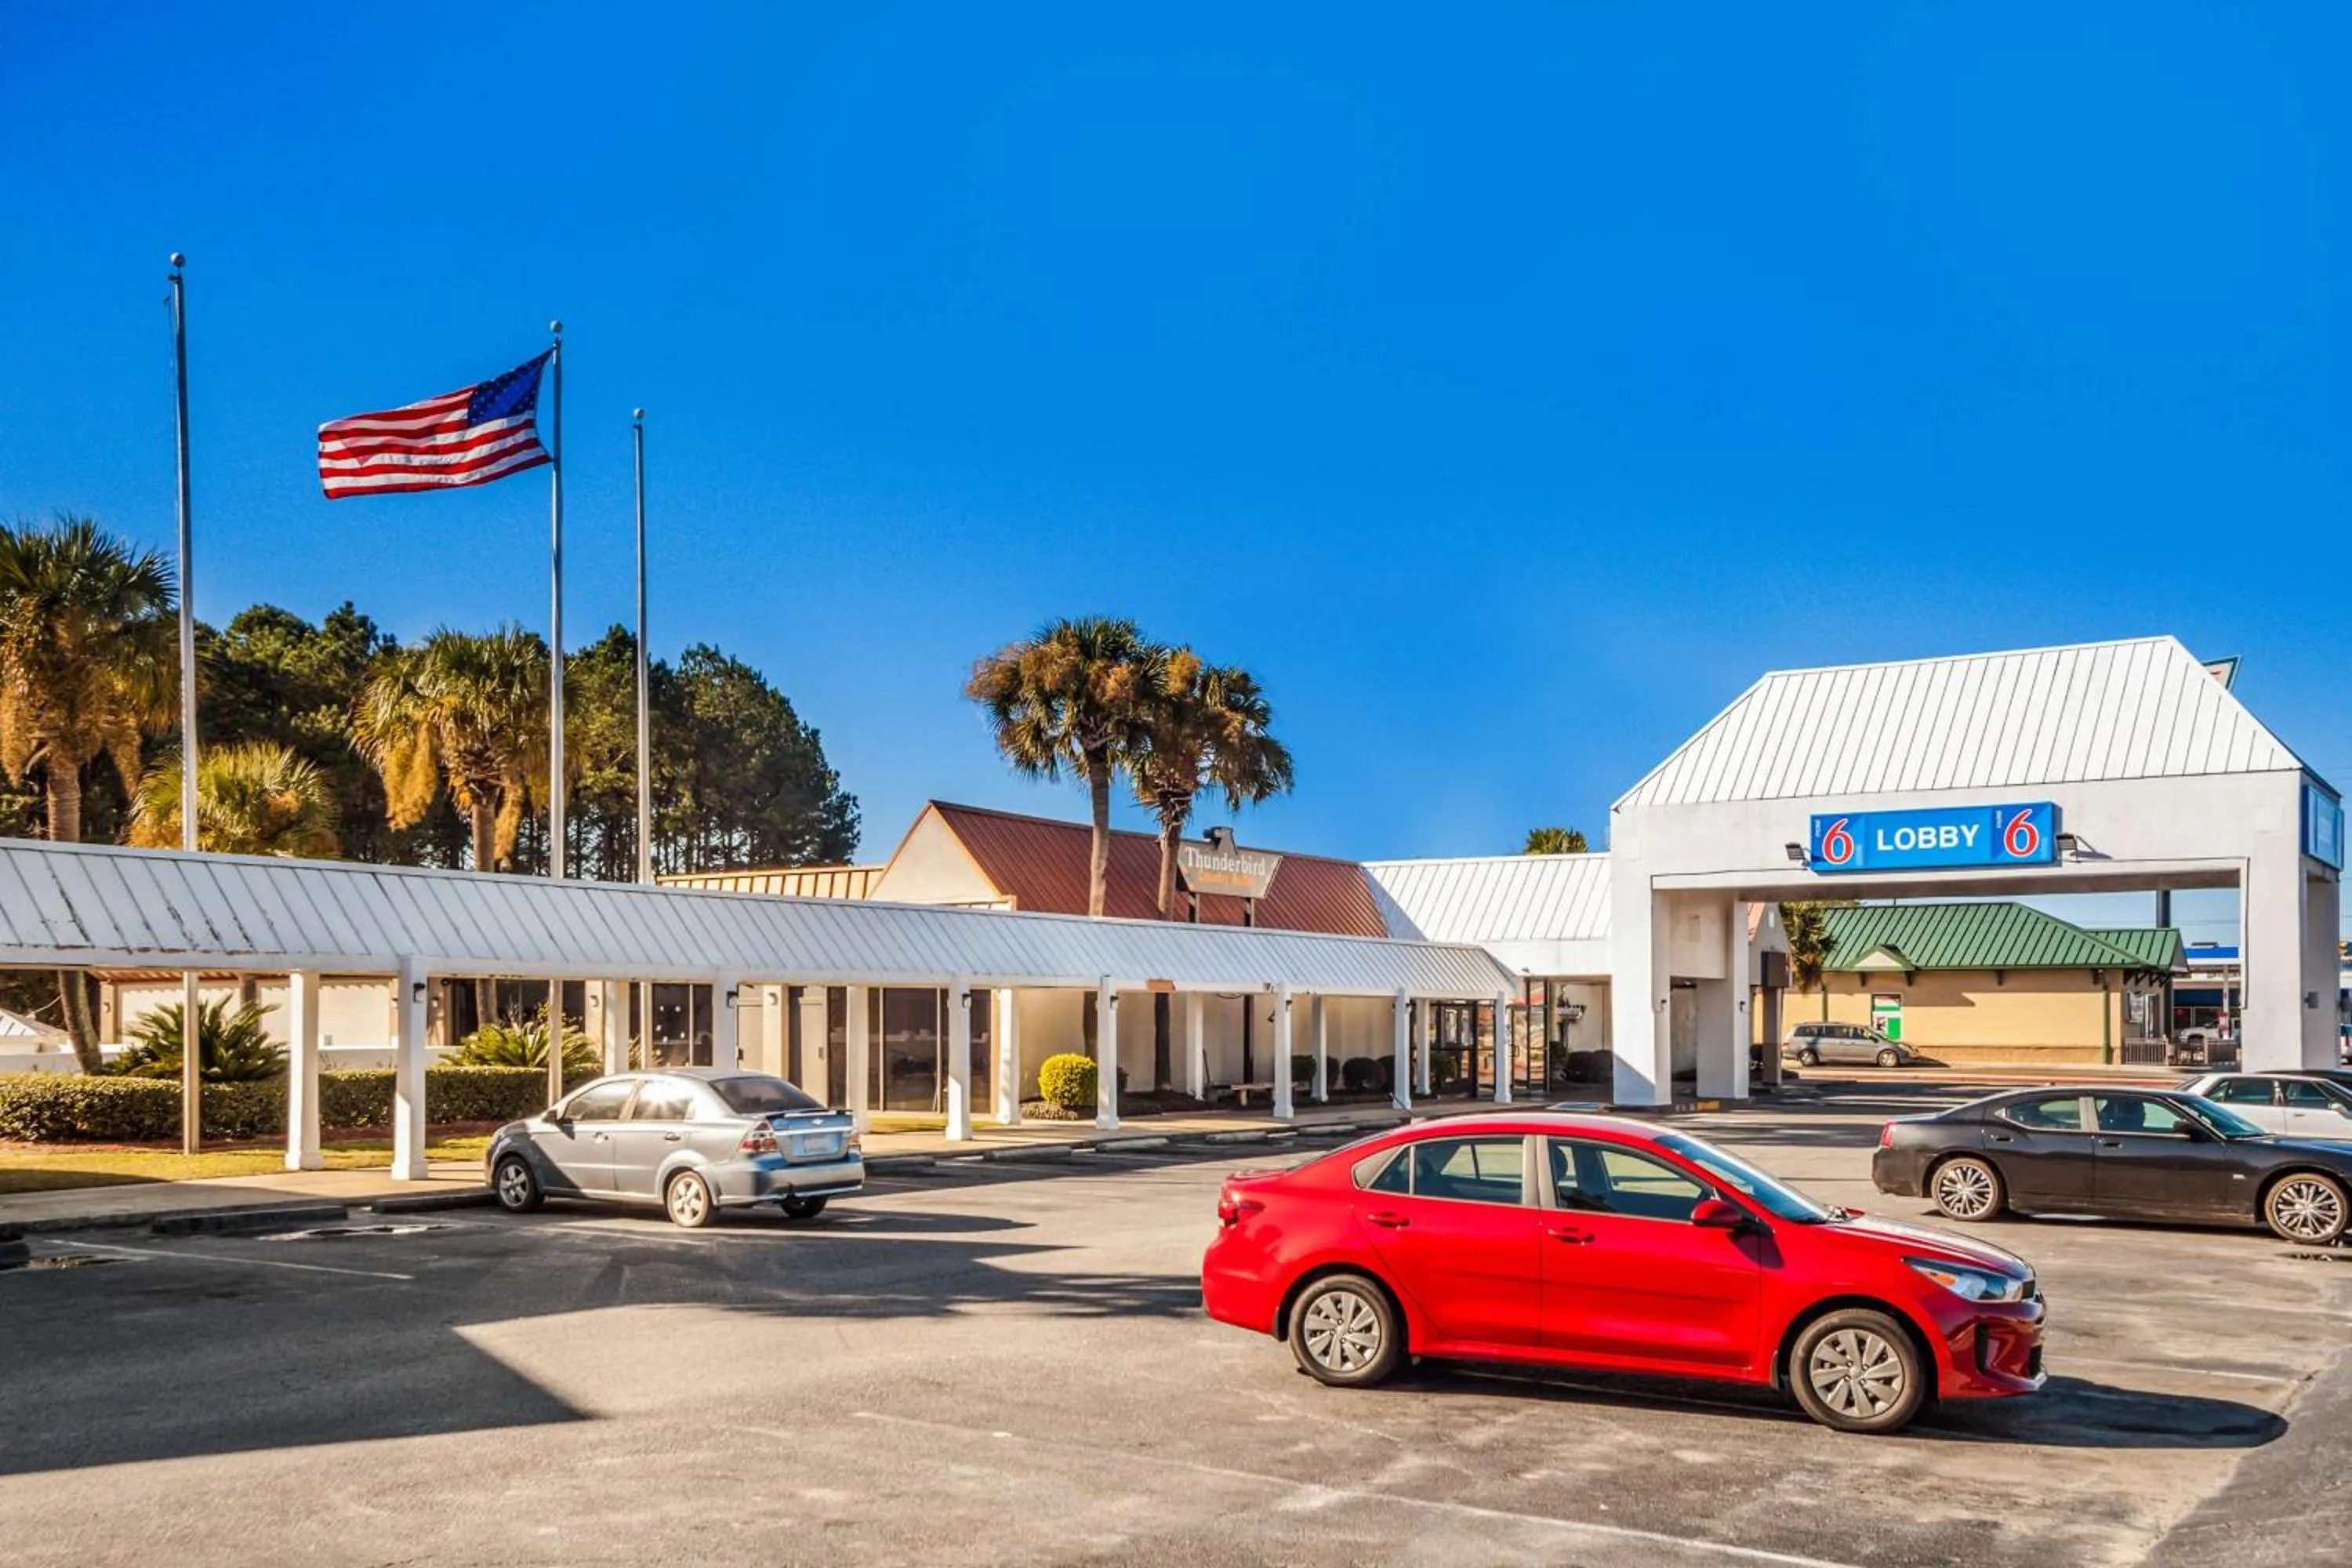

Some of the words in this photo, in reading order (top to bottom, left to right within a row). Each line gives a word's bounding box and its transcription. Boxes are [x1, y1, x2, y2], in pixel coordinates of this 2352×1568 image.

[1822, 818, 1854, 865] 6
[1877, 824, 1980, 851] LOBBY
[2003, 808, 2039, 858] 6
[1185, 846, 1265, 876] Thunderbird
